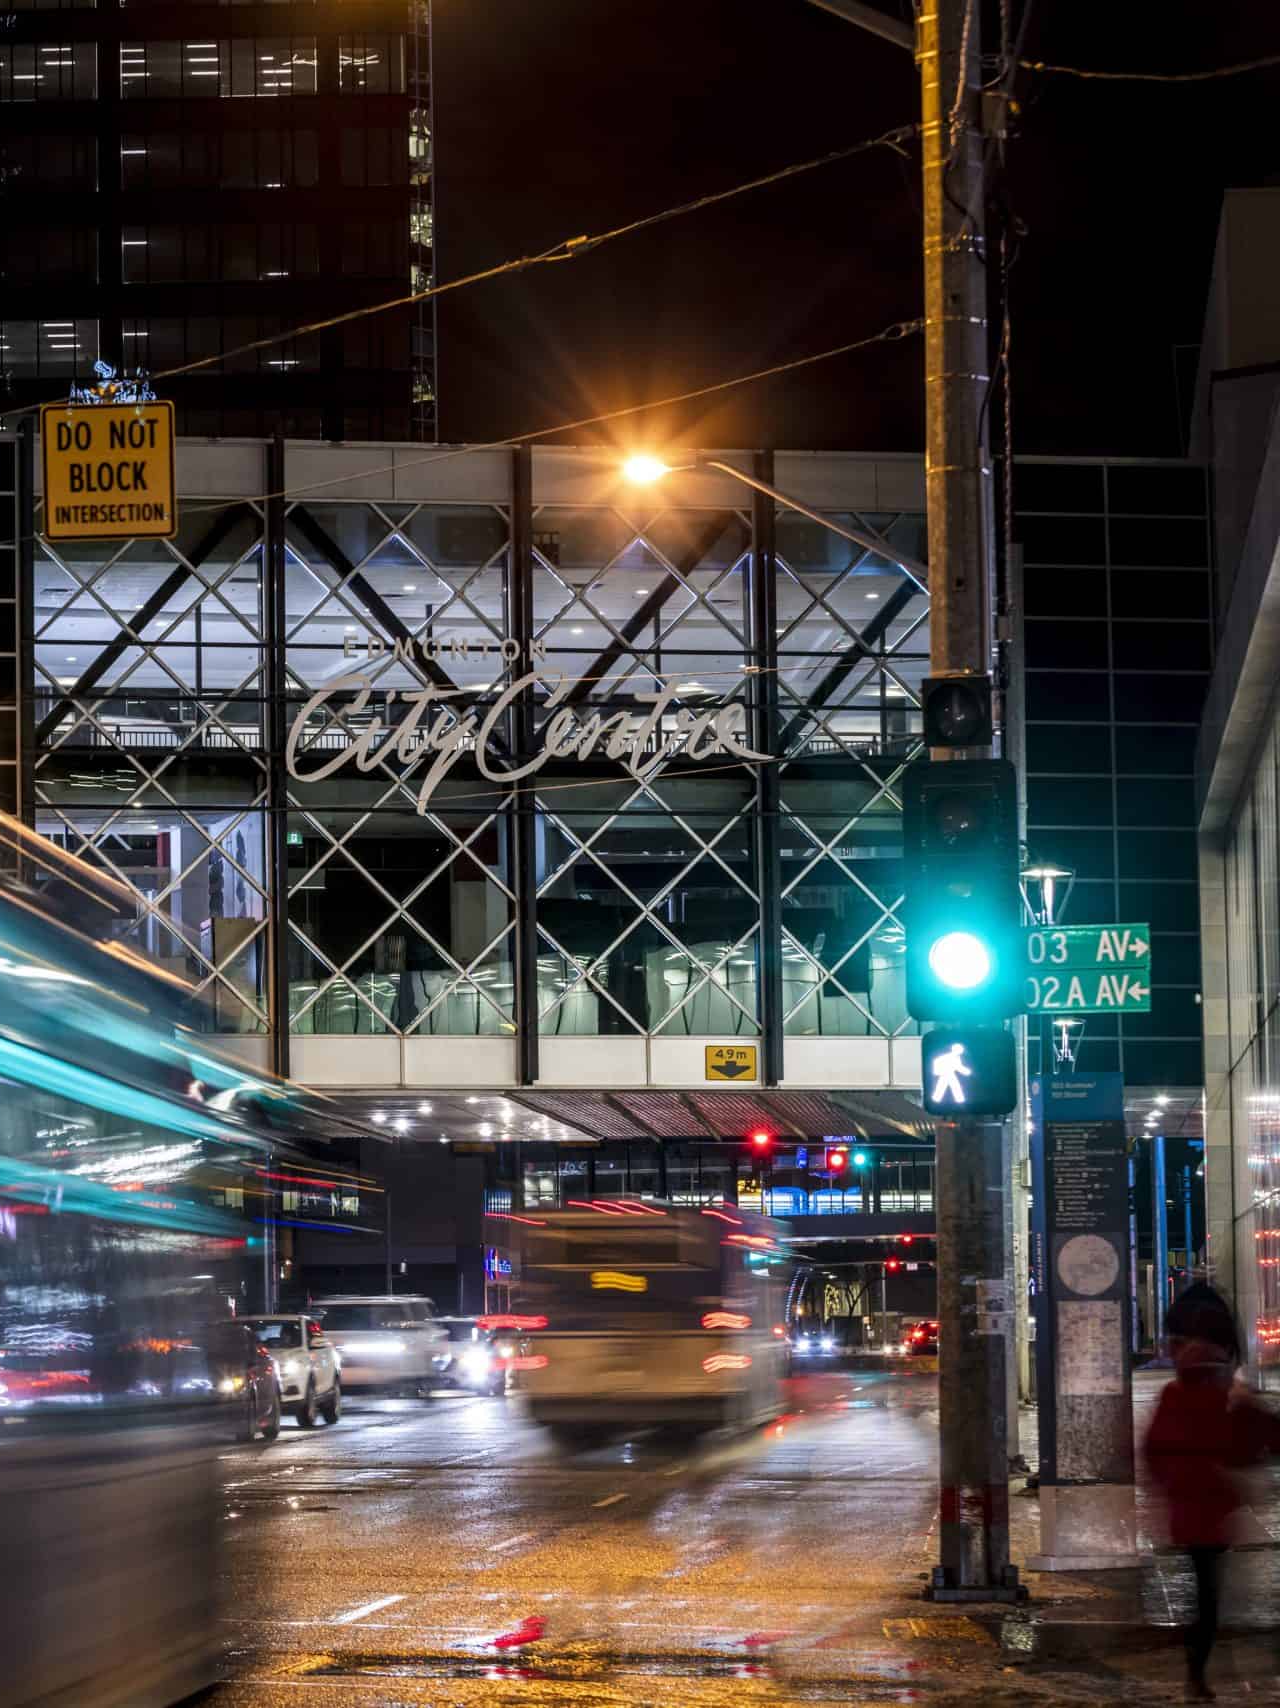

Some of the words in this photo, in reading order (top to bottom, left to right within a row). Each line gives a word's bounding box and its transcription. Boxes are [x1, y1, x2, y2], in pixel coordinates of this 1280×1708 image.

[57, 421, 92, 452] DO
[109, 418, 159, 449] NOT
[69, 461, 148, 493] BLOCK
[55, 503, 165, 525] INTERSECTION
[343, 635, 549, 663] EDMONTON
[1096, 929, 1131, 962] AV
[1095, 974, 1130, 1007] AV
